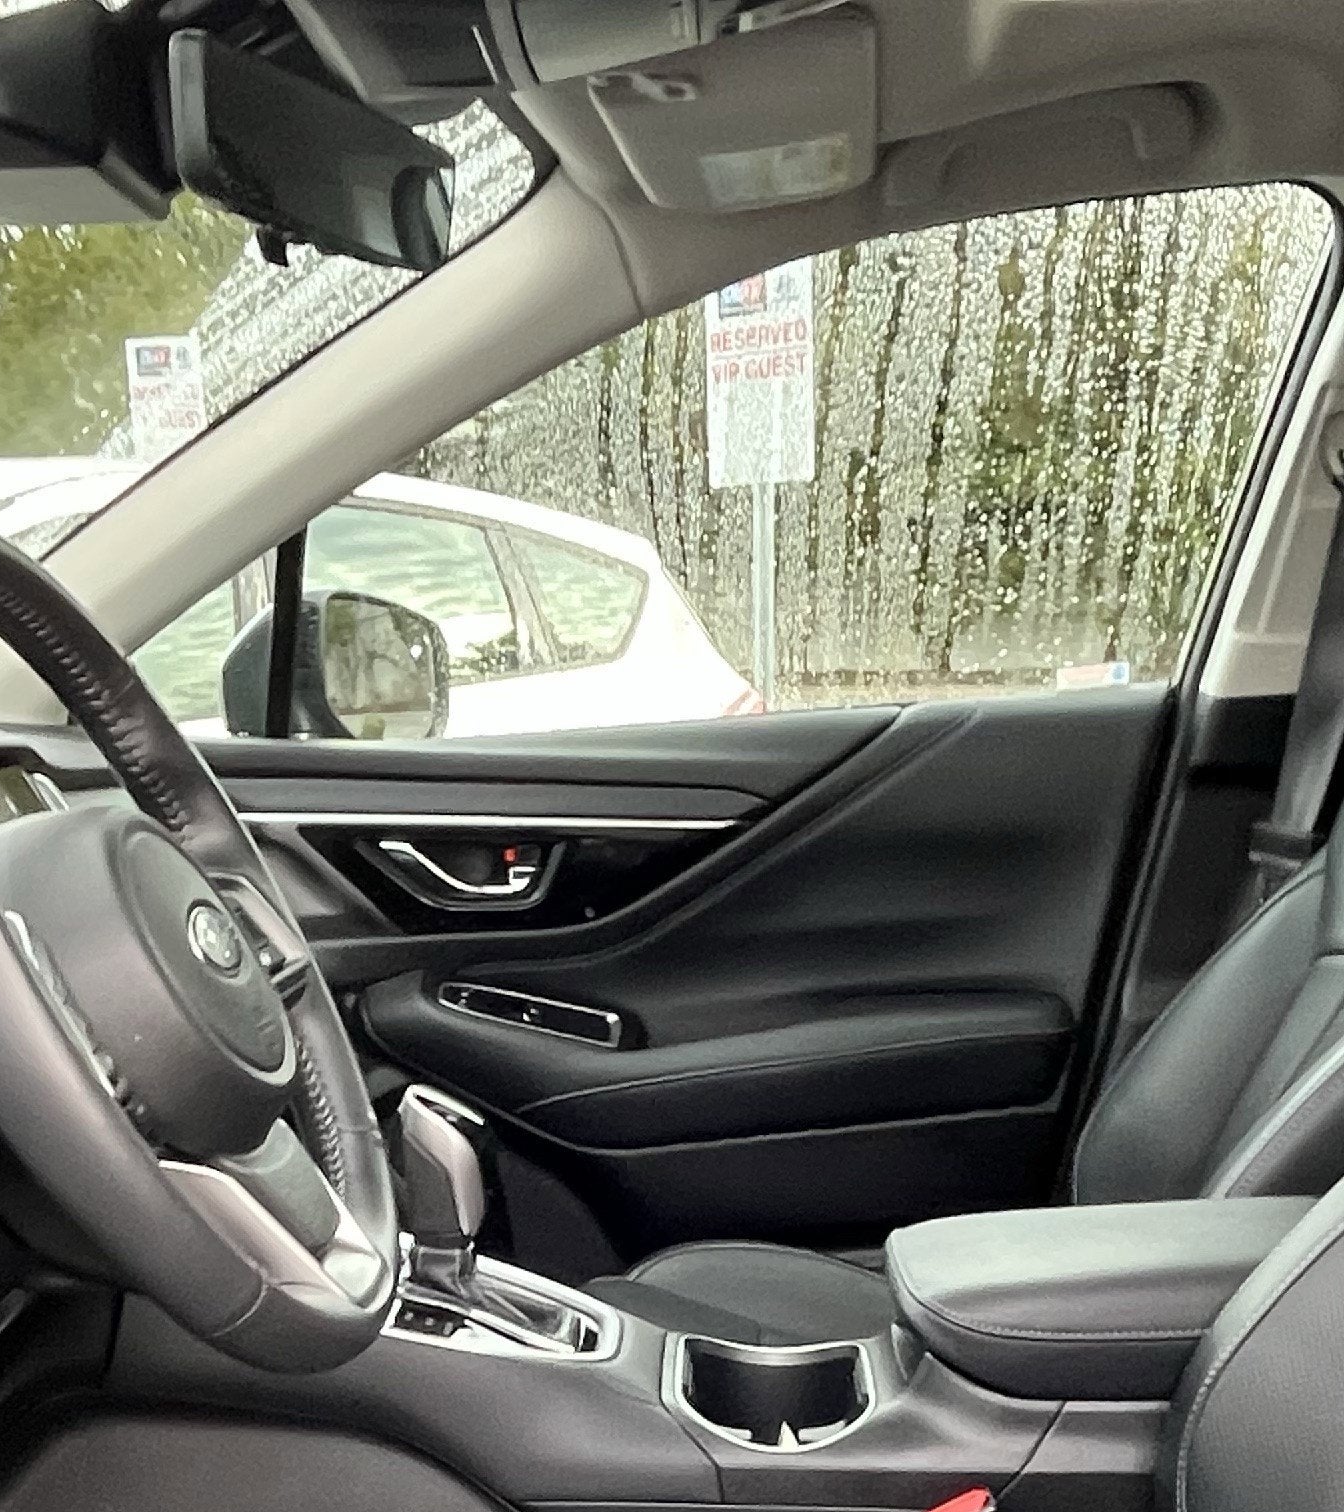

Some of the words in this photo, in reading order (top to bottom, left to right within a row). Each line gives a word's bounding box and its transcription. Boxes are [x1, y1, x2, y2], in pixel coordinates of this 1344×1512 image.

[710, 318, 808, 353] RESERVED
[712, 361, 740, 385] VIP
[744, 352, 807, 381] GUEST
